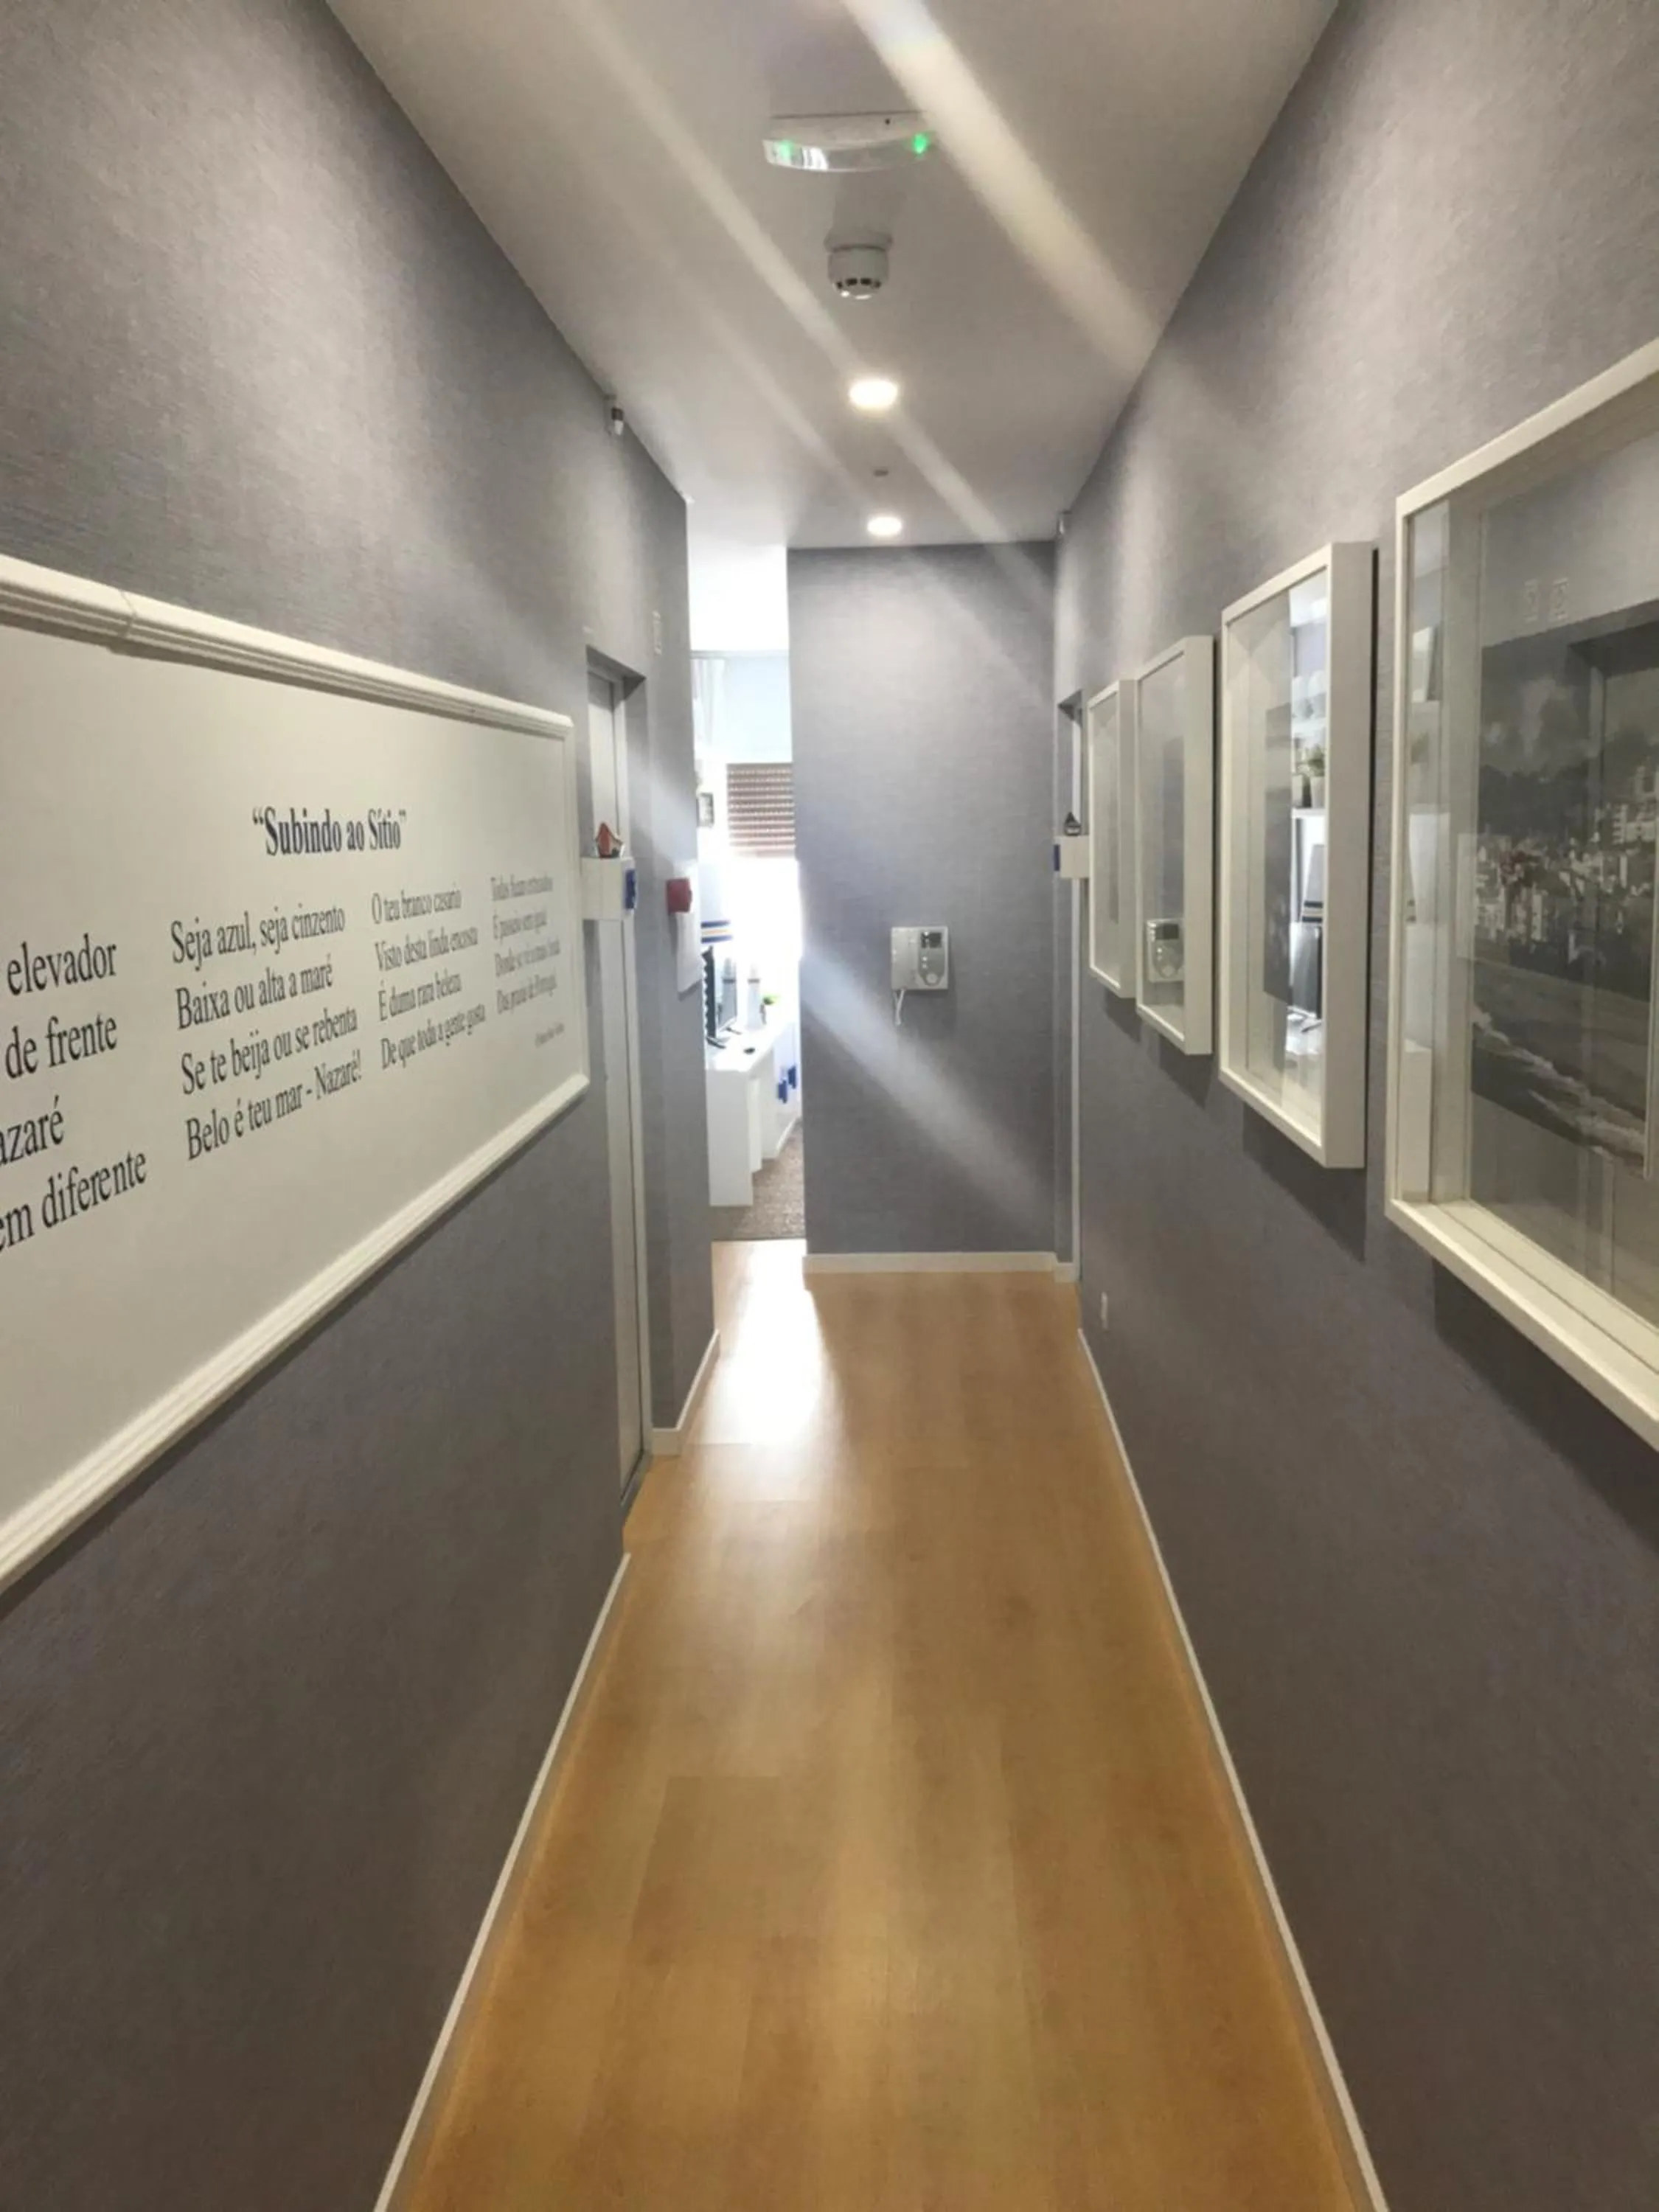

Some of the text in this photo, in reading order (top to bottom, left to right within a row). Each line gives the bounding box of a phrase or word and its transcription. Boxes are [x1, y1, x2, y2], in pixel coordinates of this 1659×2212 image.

[253, 806, 342, 856] “Subindo
[347, 821, 365, 851] ao
[170, 902, 346, 972] Seja azul, seja cinzento
[372, 892, 382, 924] O
[383, 898, 400, 922] teu
[400, 889, 431, 919] branco
[7, 933, 117, 996] elevador
[375, 940, 402, 971] Visto
[175, 953, 333, 1031] Baixa ou alta a maré
[378, 979, 388, 1021] É
[5, 1013, 118, 1079] de frente
[181, 1007, 358, 1095] Se te beija ou se rebenta
[381, 1037, 396, 1070] De
[397, 1034, 416, 1068] que
[187, 1108, 230, 1161] Belo
[234, 1097, 244, 1138] é
[248, 1097, 272, 1130] teu
[276, 1083, 304, 1120] mar
[314, 1048, 362, 1101] Nazaré!
[42, 1150, 147, 1228] diferente
